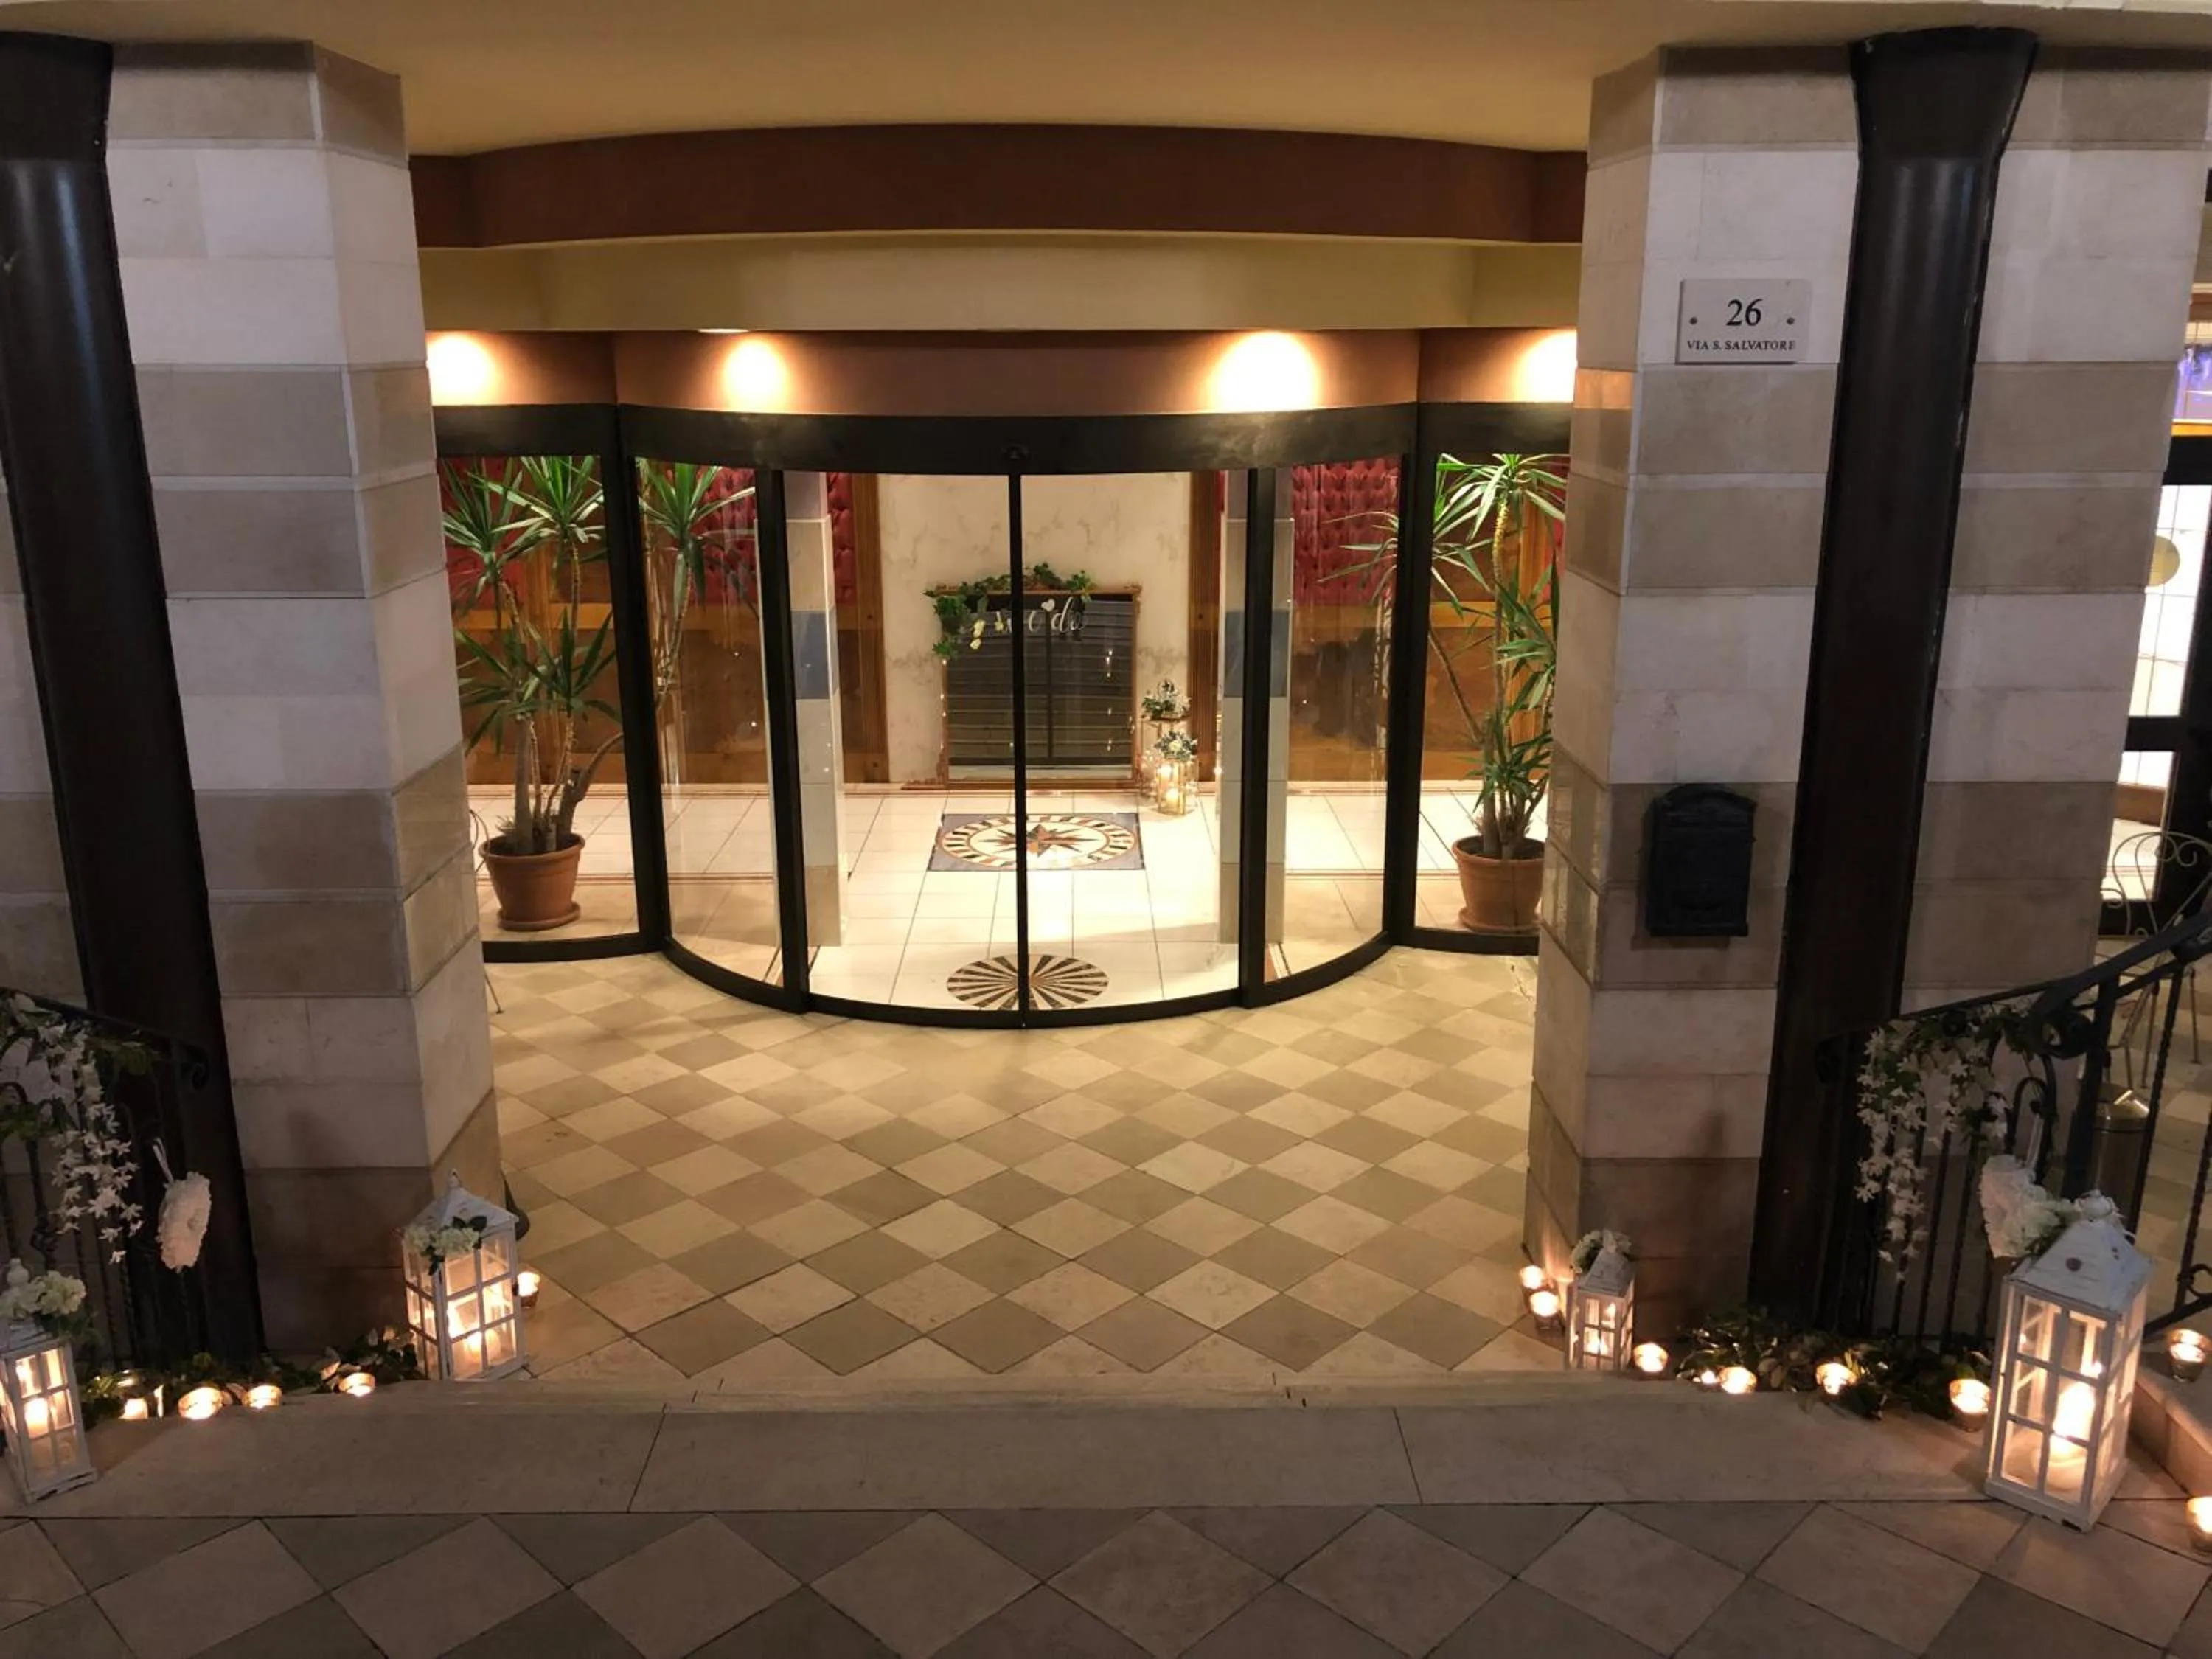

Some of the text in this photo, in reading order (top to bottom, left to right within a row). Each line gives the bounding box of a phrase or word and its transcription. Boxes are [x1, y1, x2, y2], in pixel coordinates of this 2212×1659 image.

[1726, 299, 1763, 326] 26
[1687, 340, 1709, 350] VIA
[1725, 340, 1796, 350] SALVATORE
